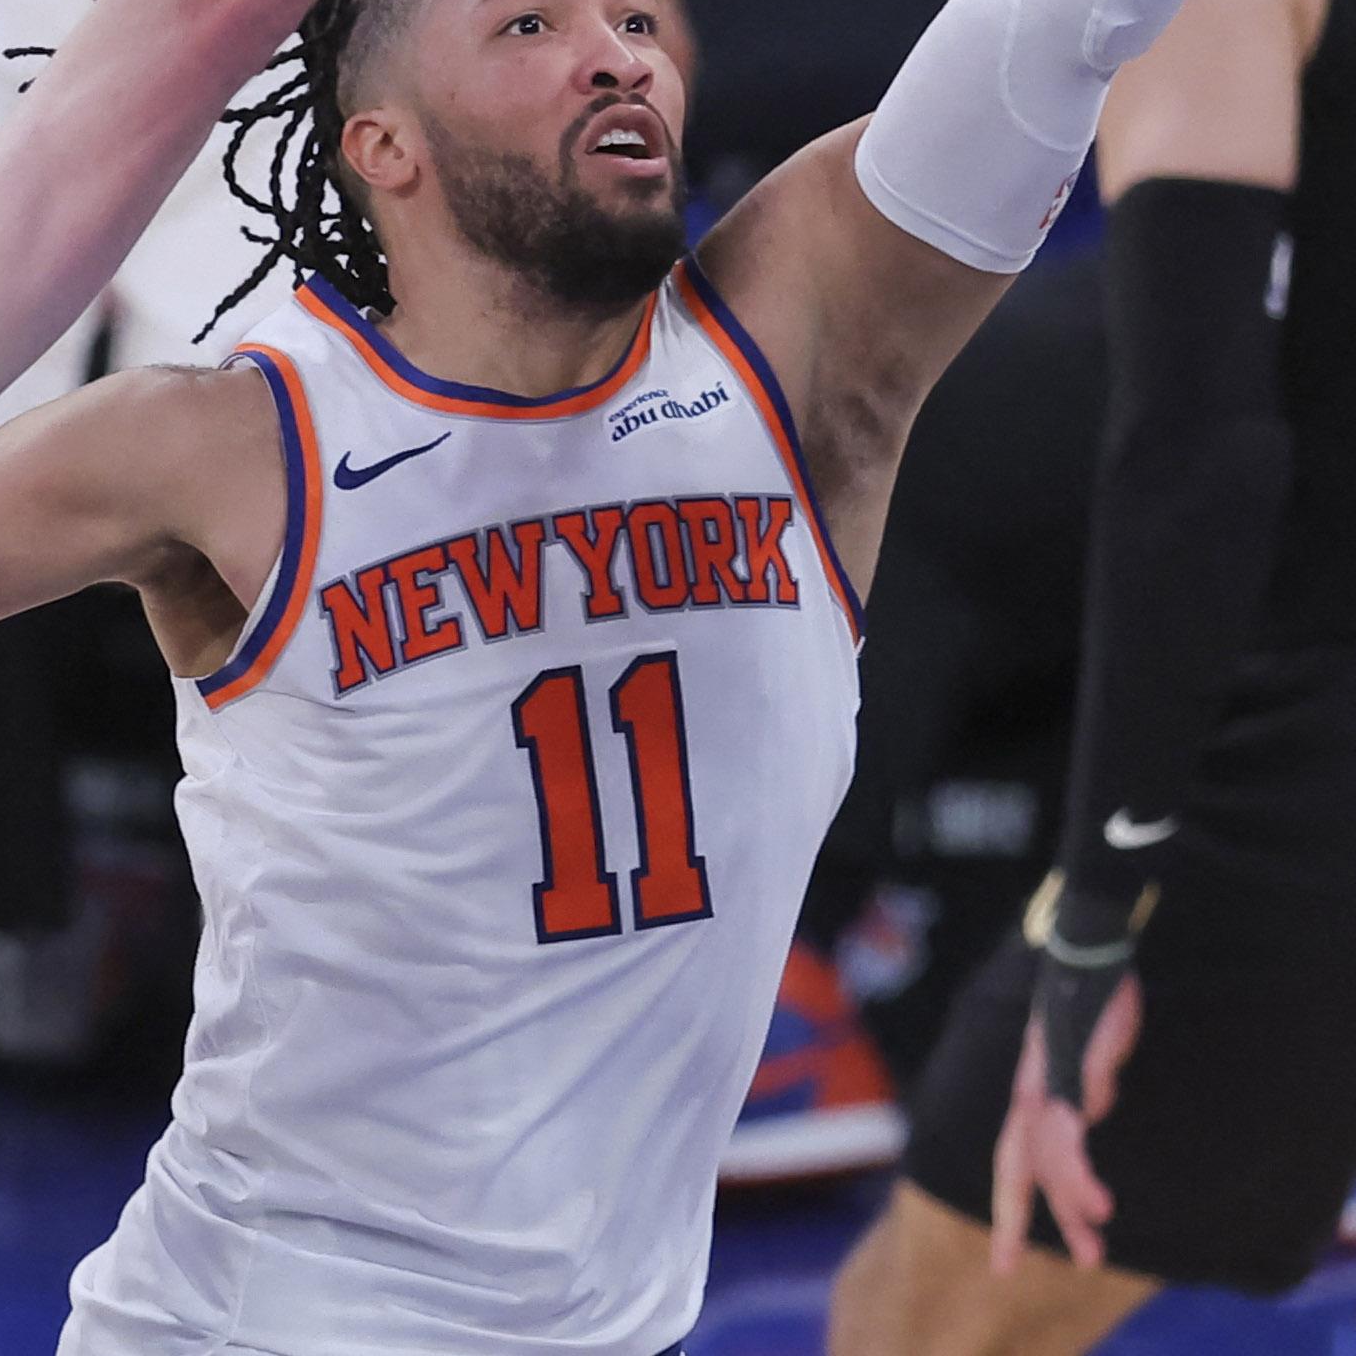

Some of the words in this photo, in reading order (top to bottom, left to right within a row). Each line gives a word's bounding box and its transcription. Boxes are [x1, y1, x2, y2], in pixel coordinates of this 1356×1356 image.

[611, 407, 659, 442] abu
[660, 381, 731, 419] dhabi
[318, 514, 546, 700] NEW
[553, 492, 801, 625] YORK
[510, 649, 715, 945] 11
